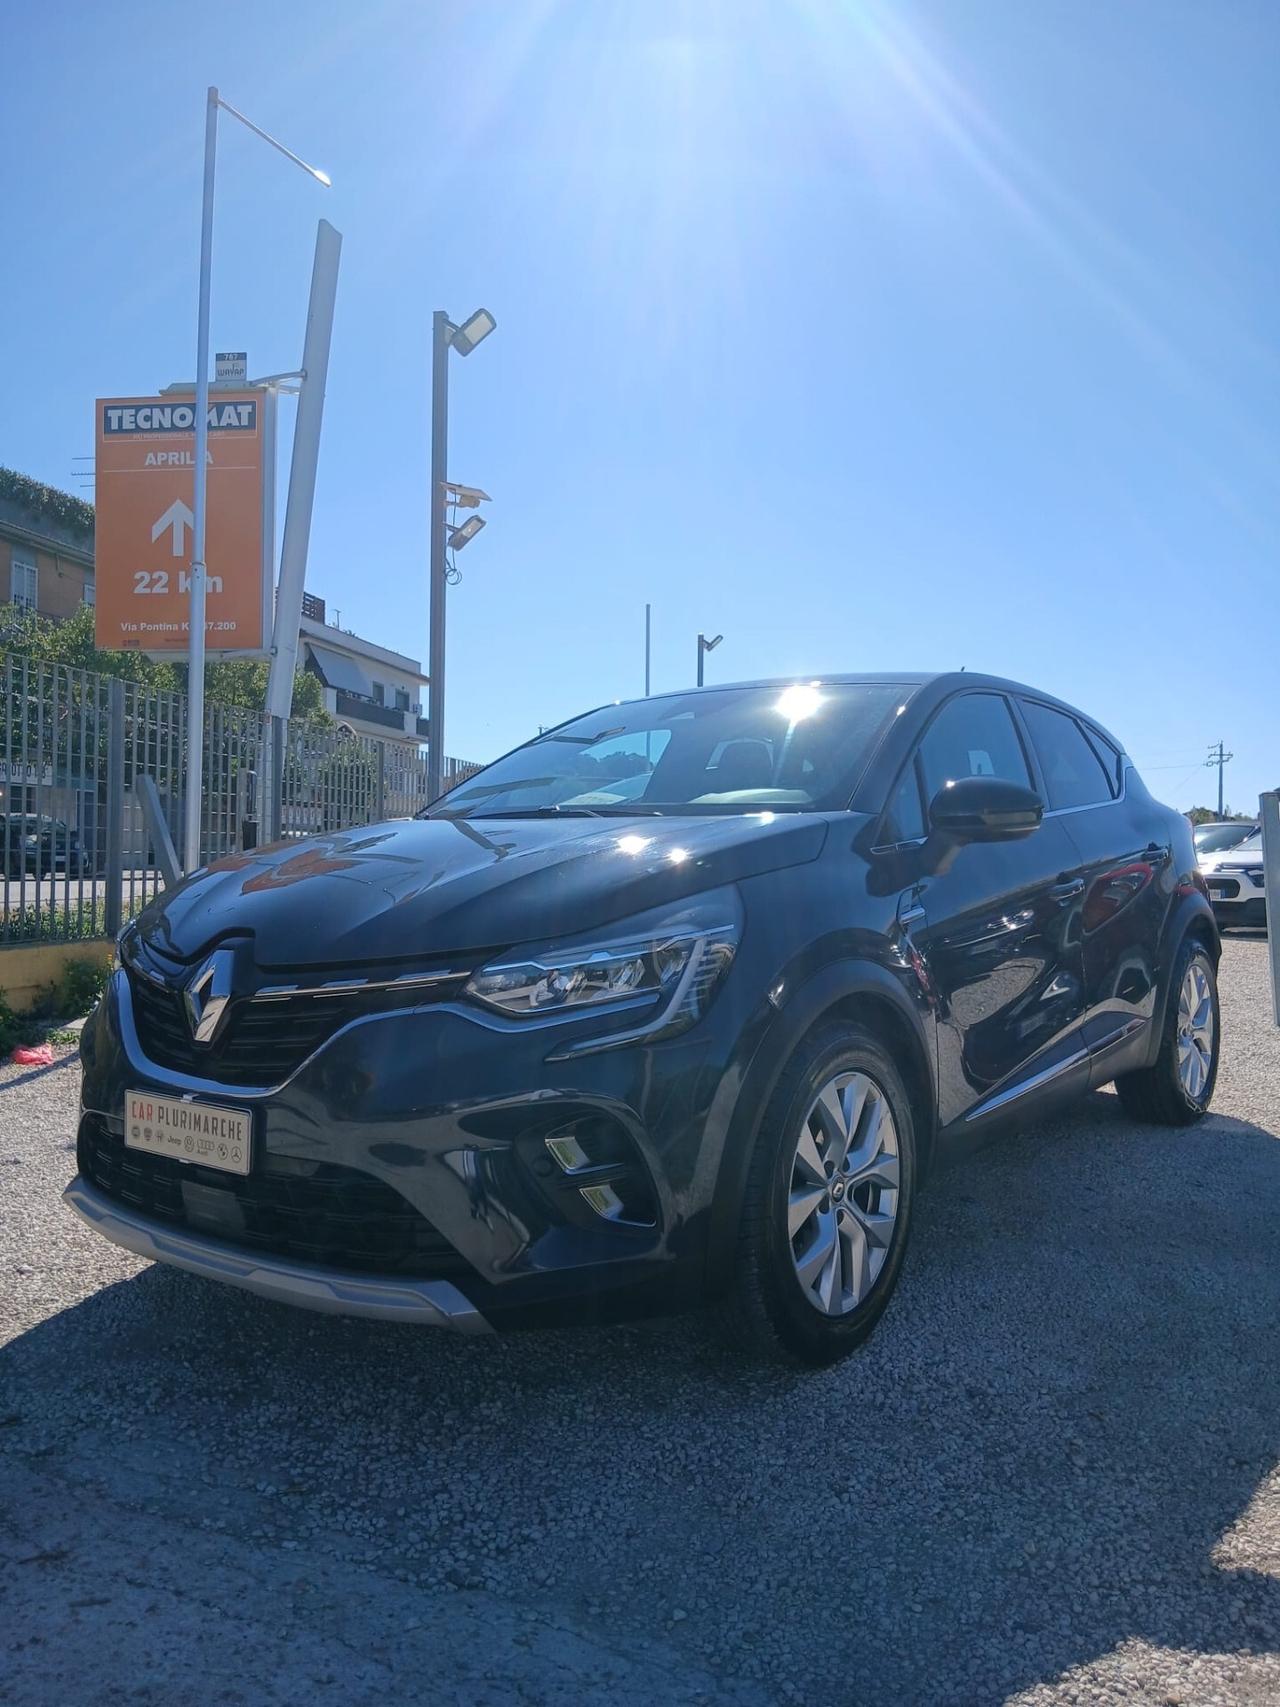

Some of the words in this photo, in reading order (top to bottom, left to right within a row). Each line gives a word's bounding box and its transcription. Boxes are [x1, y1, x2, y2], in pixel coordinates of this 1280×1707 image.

[107, 404, 253, 431] TECNOMAT
[145, 451, 214, 466] APRILA
[133, 571, 169, 594] 22
[178, 571, 223, 593] km
[120, 622, 138, 632] Via
[140, 622, 179, 631] Pontina
[203, 621, 237, 631] 7.200
[131, 1101, 153, 1121] CAR
[158, 1105, 242, 1141] PLURIMARCHE
